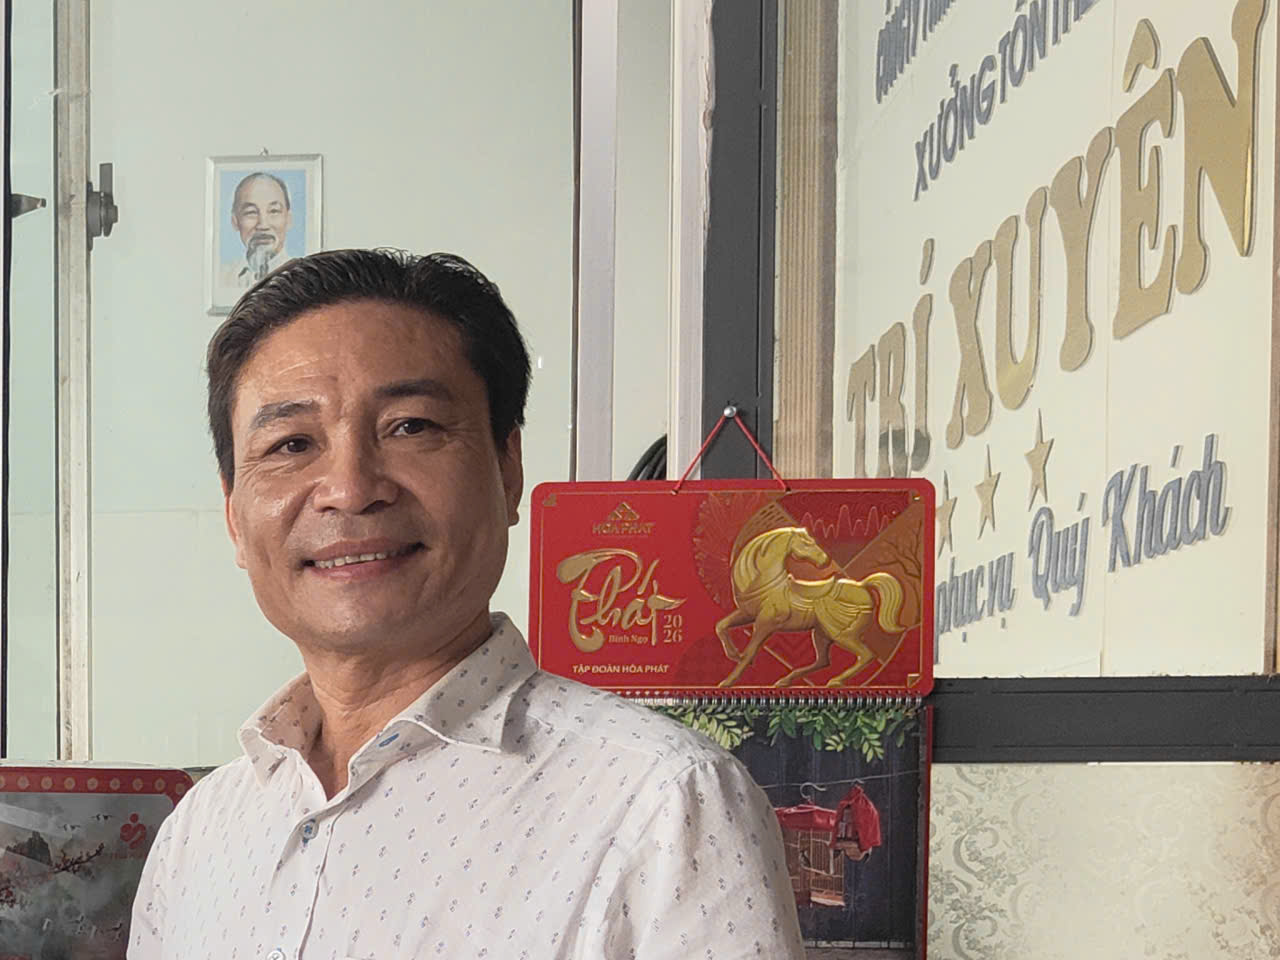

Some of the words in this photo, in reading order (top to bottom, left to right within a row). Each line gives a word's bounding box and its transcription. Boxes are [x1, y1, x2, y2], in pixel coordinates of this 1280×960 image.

[846, 237, 933, 478] TRÍ
[946, 0, 1268, 450] XUYÊN
[1028, 492, 1089, 617] Quý
[1102, 434, 1232, 573] Khách
[663, 614, 683, 628] 20
[663, 629, 683, 643] 26
[572, 664, 591, 676] TẬP
[645, 663, 670, 674] PHÁT
